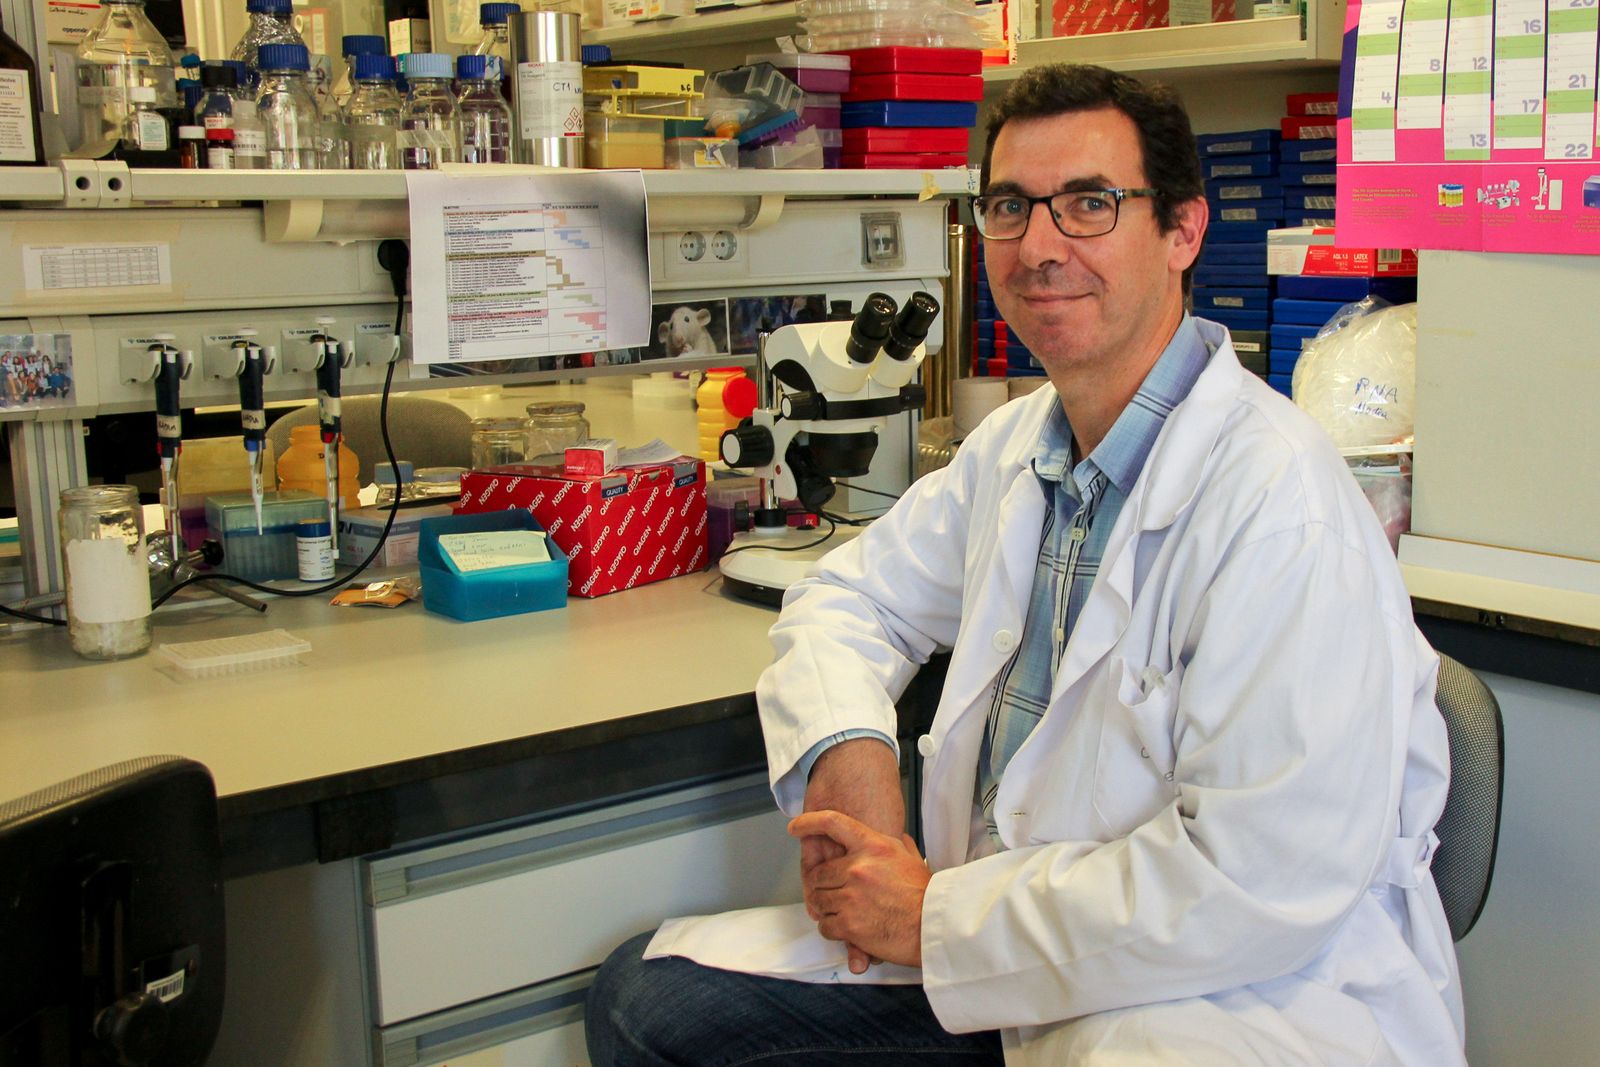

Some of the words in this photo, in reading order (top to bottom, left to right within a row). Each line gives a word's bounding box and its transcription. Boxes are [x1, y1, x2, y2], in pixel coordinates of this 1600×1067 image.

[1386, 16, 1398, 29] 3
[1523, 19, 1542, 33] 16
[1430, 58, 1440, 72] 8
[1472, 57, 1488, 70] 12
[1568, 74, 1586, 88] 21
[1381, 91, 1392, 104] 4
[1522, 100, 1540, 112] 17
[1470, 134, 1487, 147] 13
[1564, 144, 1588, 157] 22
[478, 478, 499, 506] QIAGEN
[552, 480, 574, 506] QIAGEN
[606, 486, 624, 496] QUALITY
[642, 486, 659, 516] QIAGEN
[680, 488, 697, 517] QIAGEN
[570, 504, 593, 532] QIAGEN
[617, 506, 636, 536] QIAGEN
[657, 506, 675, 536] QIAGEN
[590, 526, 610, 556] QIAGEN
[633, 526, 652, 556] QIAGEN
[672, 526, 690, 556] QIAGEN
[608, 546, 627, 576] QIAGEN
[648, 545, 667, 576] QIAGEN
[580, 566, 602, 594] QIAGEN
